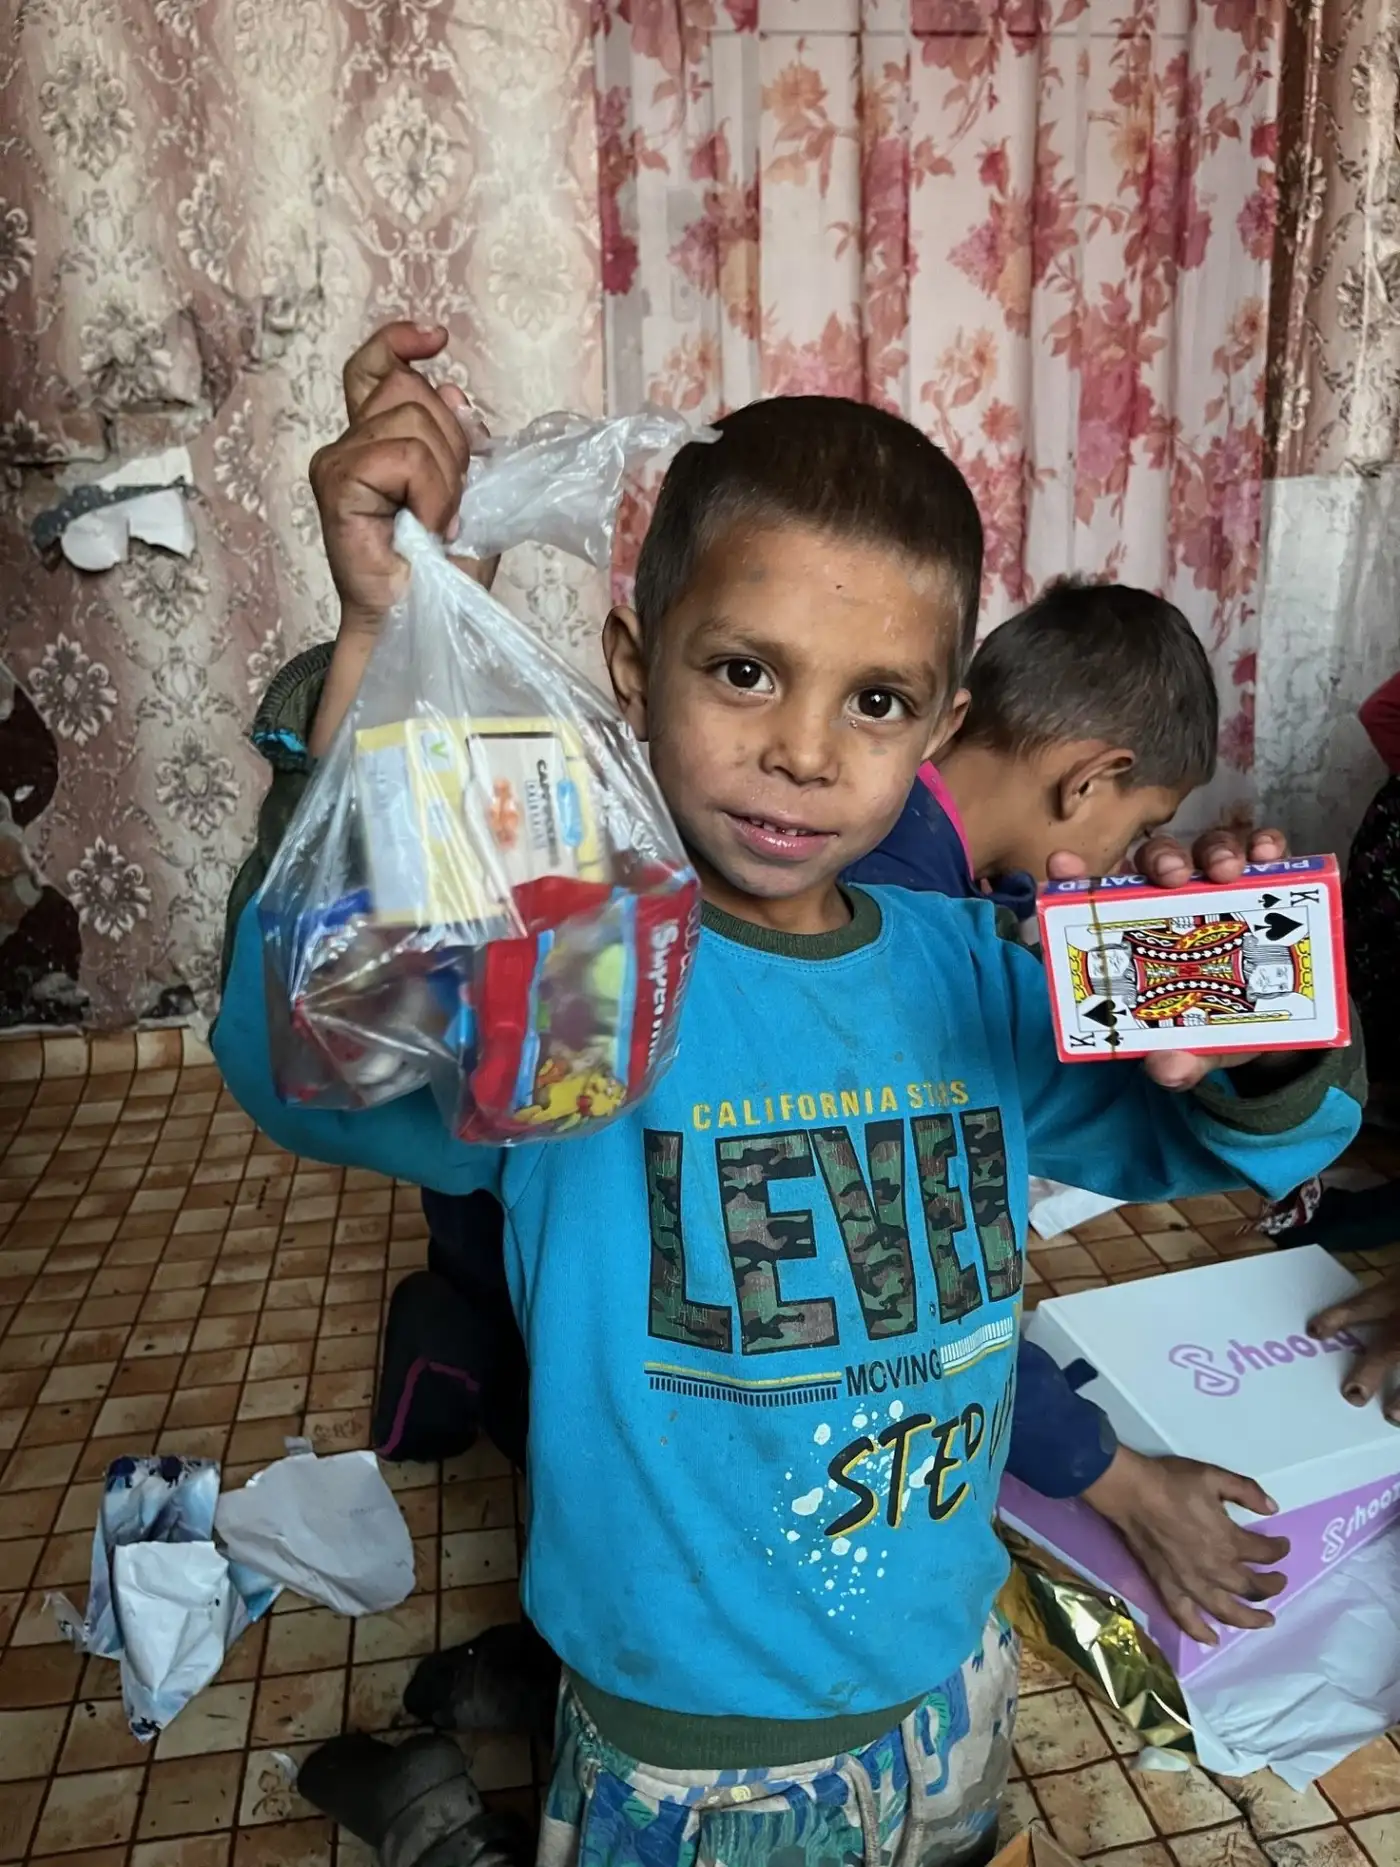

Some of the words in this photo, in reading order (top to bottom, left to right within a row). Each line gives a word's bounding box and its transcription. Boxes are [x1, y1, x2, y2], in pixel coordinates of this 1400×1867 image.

[1057, 874, 1148, 891] OATED
[1290, 888, 1320, 905] K
[1069, 1032, 1096, 1049] K
[692, 1085, 898, 1131] CALIFORNIA
[643, 1106, 1023, 1356] LEVEL
[845, 1349, 942, 1398] MOVING
